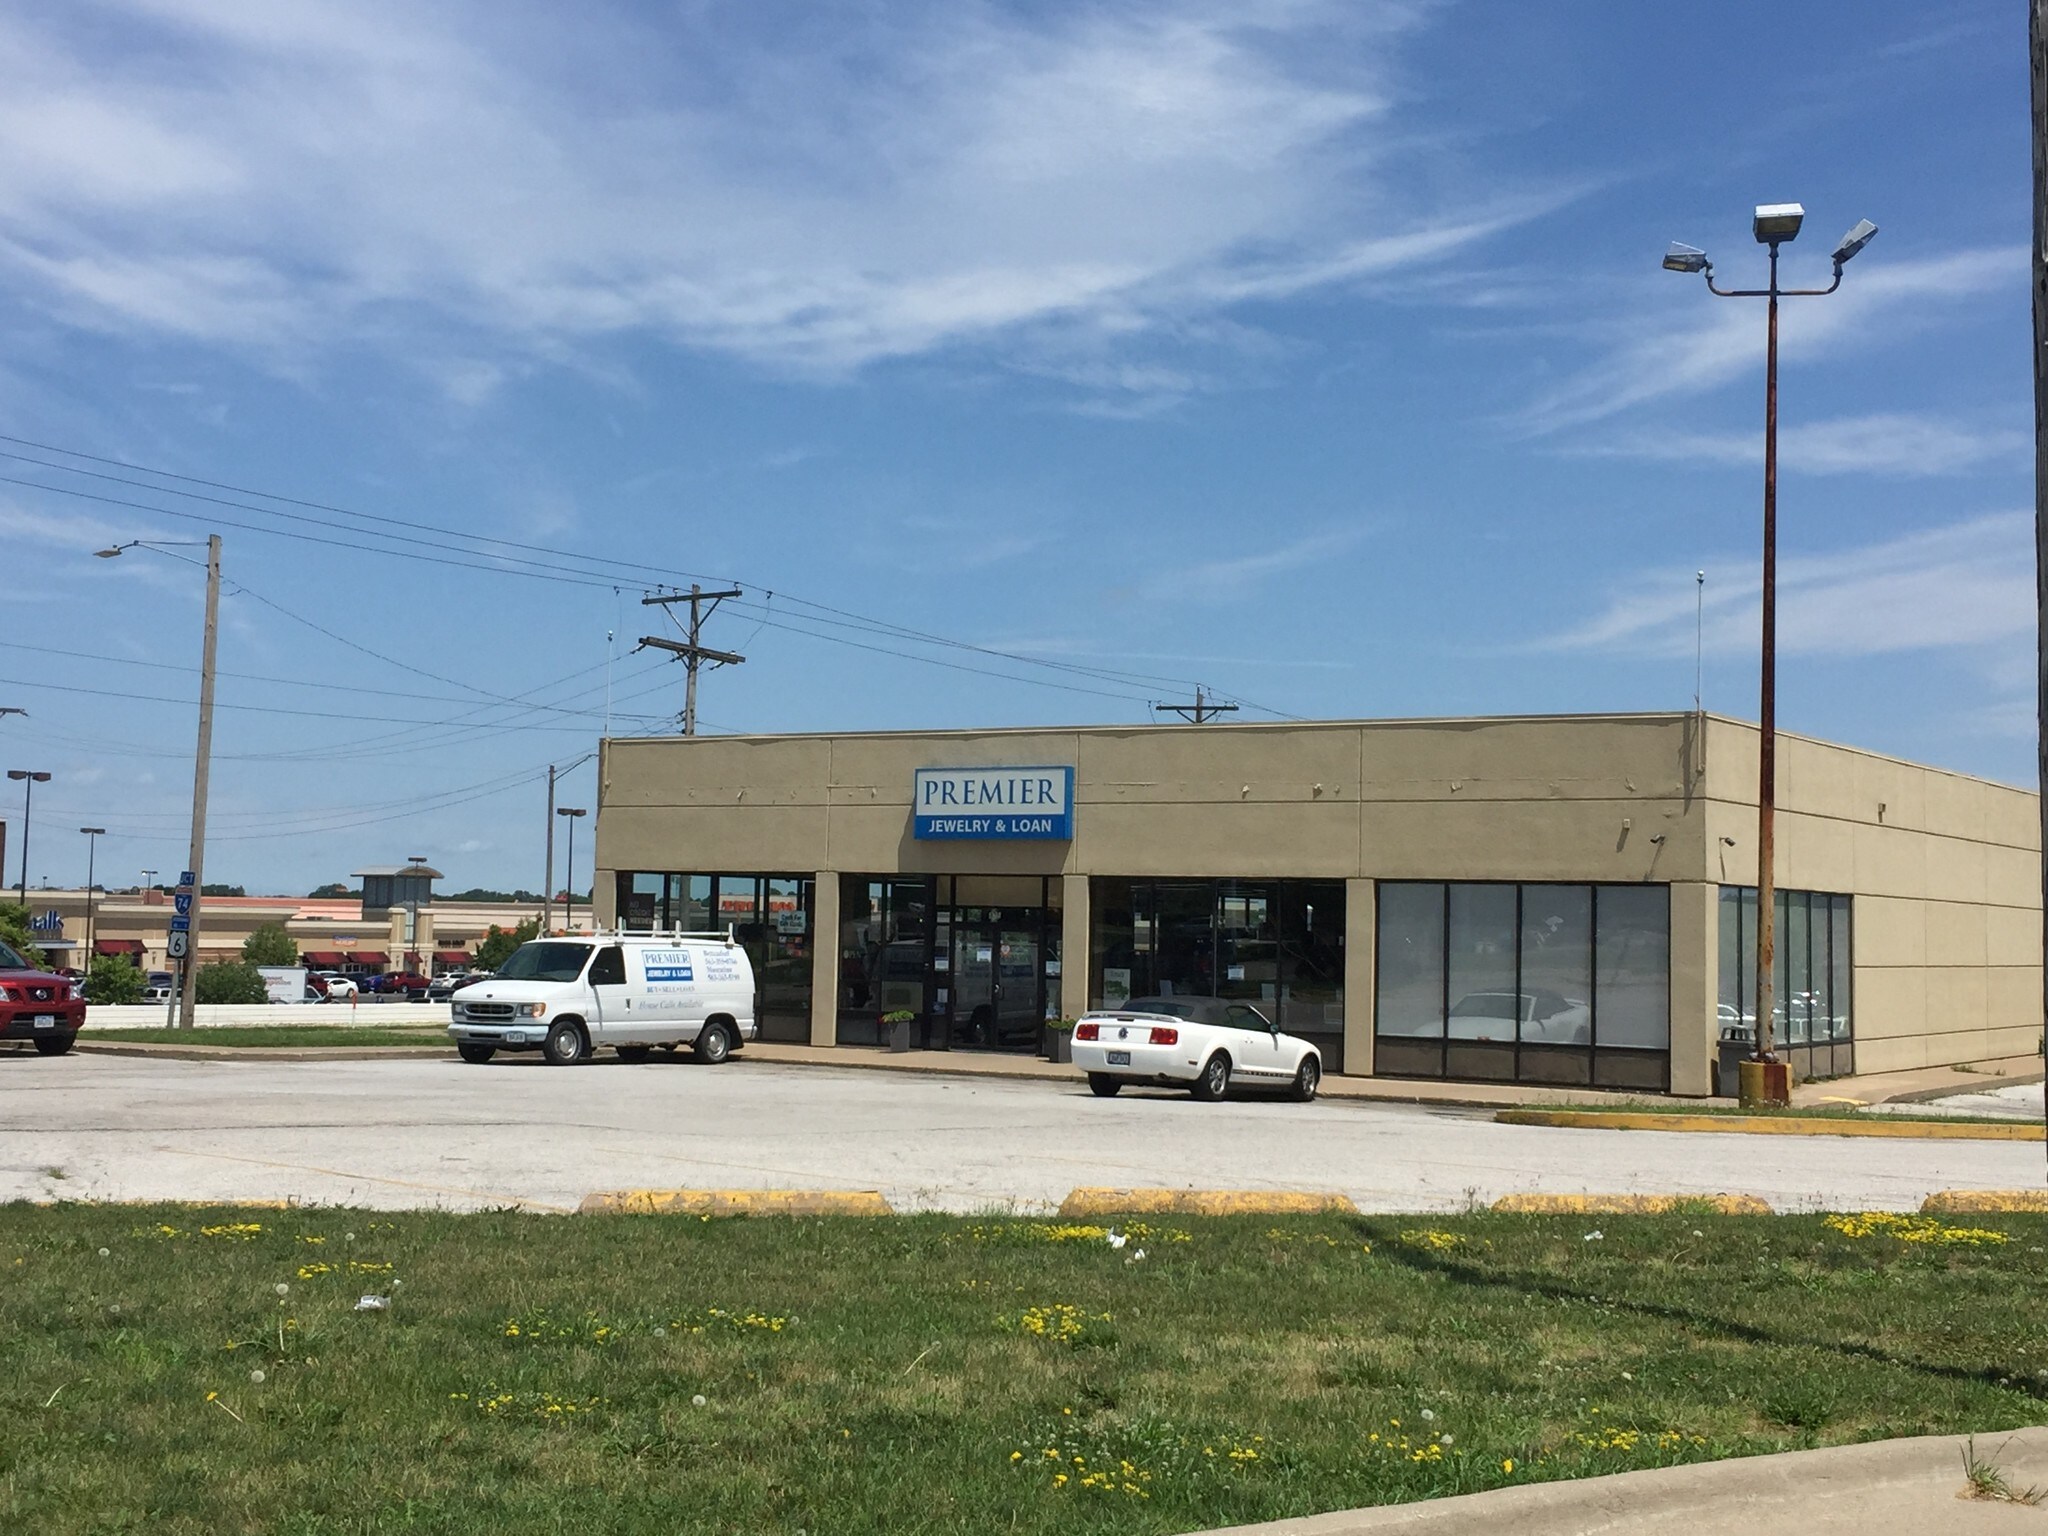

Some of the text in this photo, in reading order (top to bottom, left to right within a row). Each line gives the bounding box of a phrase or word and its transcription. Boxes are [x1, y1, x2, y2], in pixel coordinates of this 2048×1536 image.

[924, 778, 1058, 805] PREMIER
[928, 819, 1052, 833] JEWELRY & LOAN
[180, 873, 194, 884] JCT
[177, 897, 189, 909] 74
[173, 936, 182, 953] 6
[645, 953, 689, 965] PREMIER
